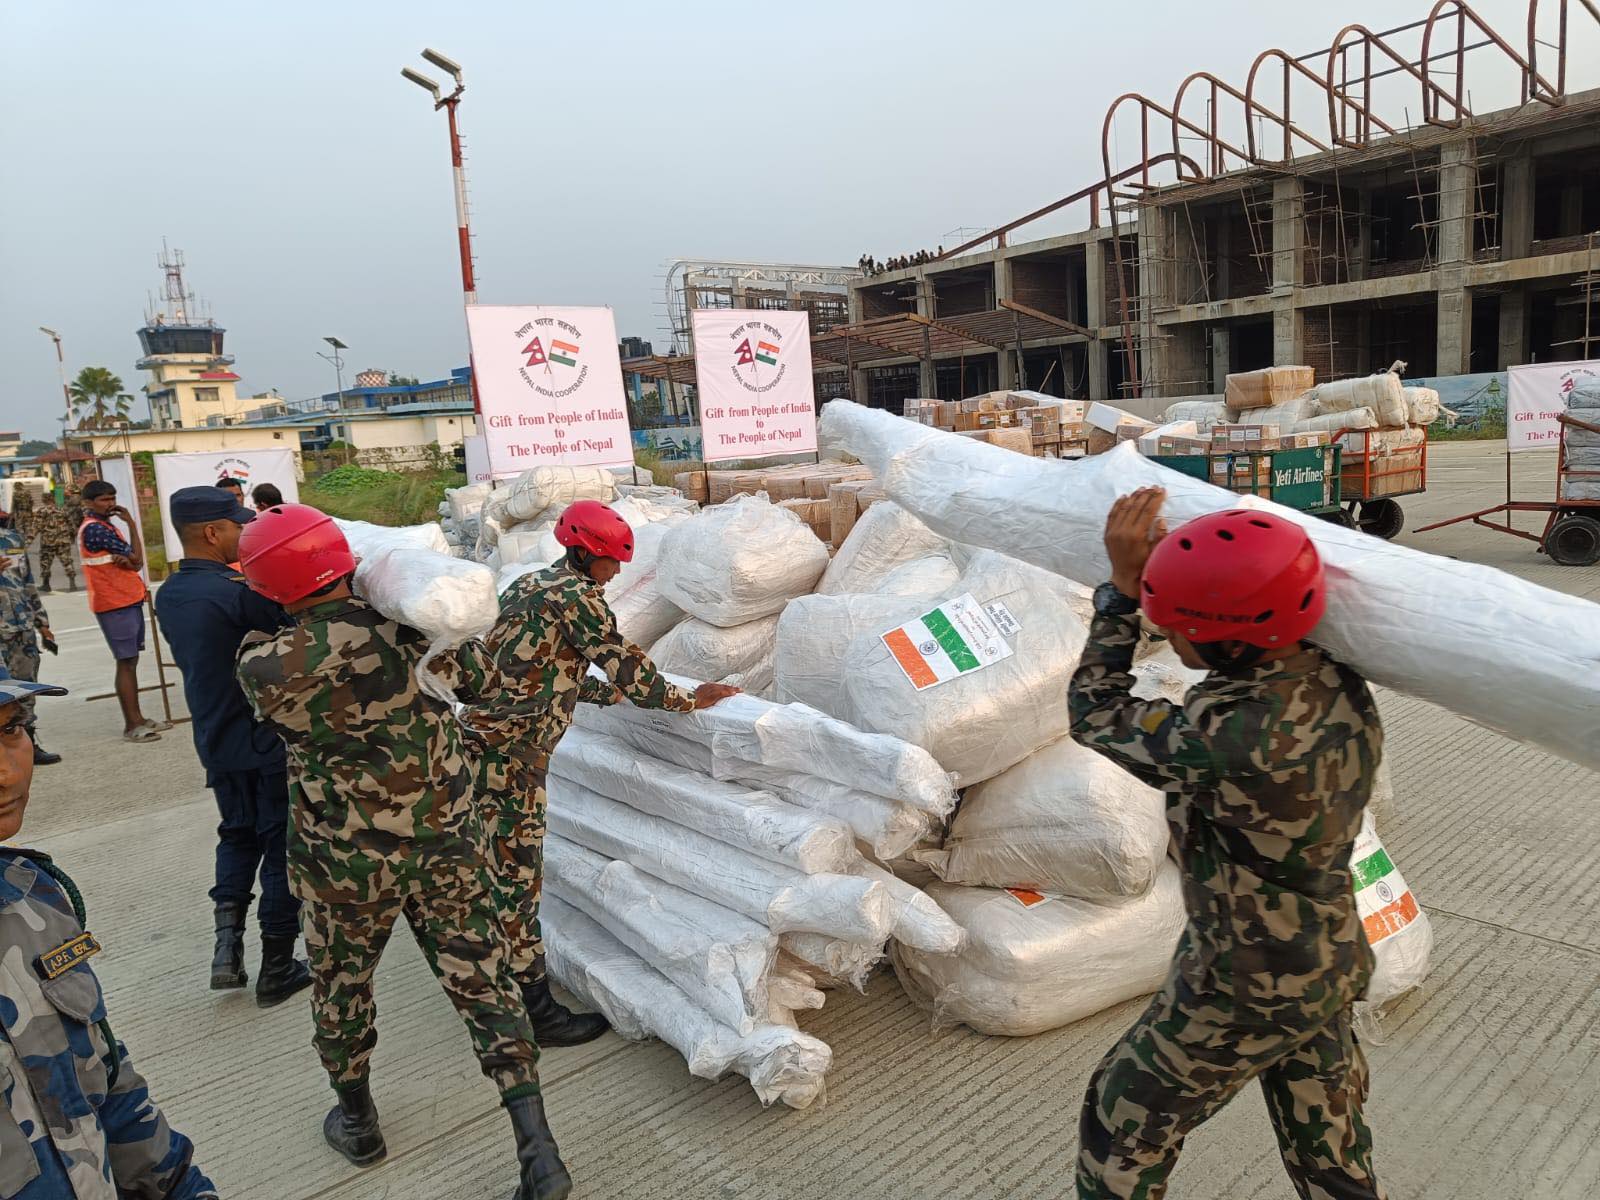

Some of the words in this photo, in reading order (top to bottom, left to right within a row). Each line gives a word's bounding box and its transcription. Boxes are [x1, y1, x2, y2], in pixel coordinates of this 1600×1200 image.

[518, 367, 536, 389] NEPAL
[535, 385, 554, 398] INDIA
[554, 364, 588, 398] COOPERATION
[489, 415, 513, 428] Gift
[518, 414, 545, 426] from
[547, 411, 583, 426] People
[584, 410, 596, 422] of
[598, 408, 624, 421] India
[705, 408, 724, 419] Gift
[728, 407, 750, 418] from
[751, 405, 779, 418] People
[780, 404, 790, 414] of
[791, 402, 812, 413] India
[1514, 412, 1534, 422] Gift
[554, 428, 565, 438] to
[756, 420, 765, 429] to
[718, 434, 737, 445] The
[738, 431, 767, 445] People
[767, 430, 777, 441] of
[779, 428, 802, 441] Nepal
[1526, 431, 1545, 441] The
[507, 445, 530, 457] The
[533, 442, 568, 456] People
[570, 440, 581, 452] of
[583, 438, 614, 452] Nepal
[1275, 468, 1291, 487] Yeti
[1293, 466, 1324, 485] Airlines
